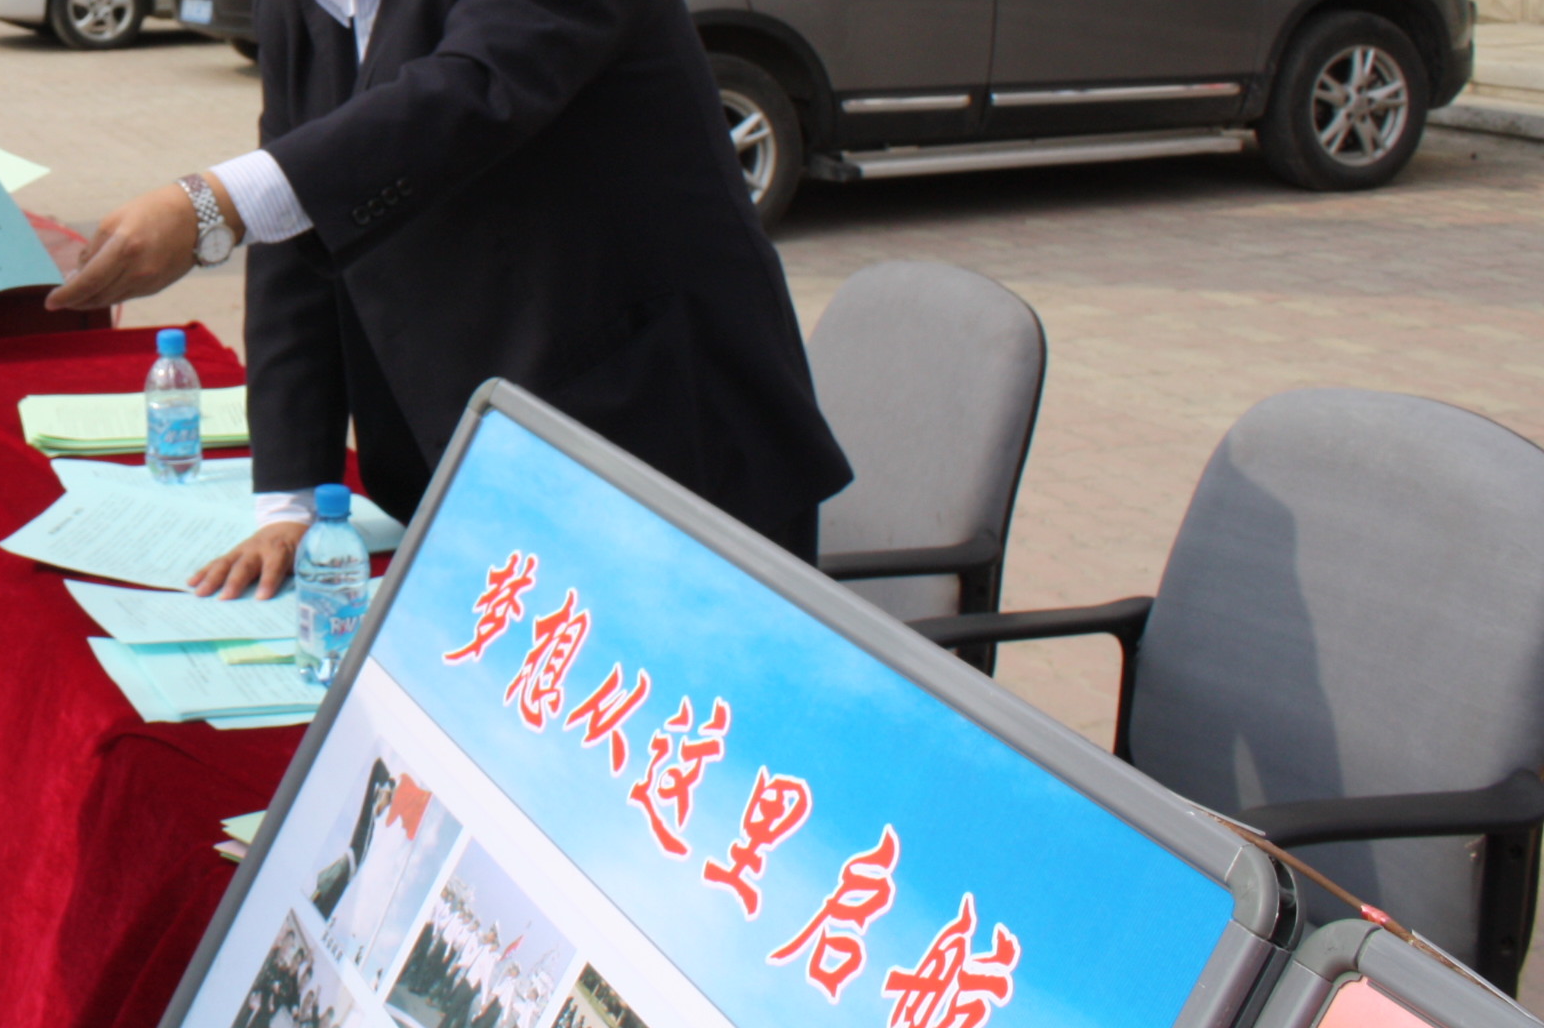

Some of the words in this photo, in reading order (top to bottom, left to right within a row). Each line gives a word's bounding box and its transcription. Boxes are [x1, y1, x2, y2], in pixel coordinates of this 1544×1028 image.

[442, 550, 1020, 1028] 梦想从这里启航
